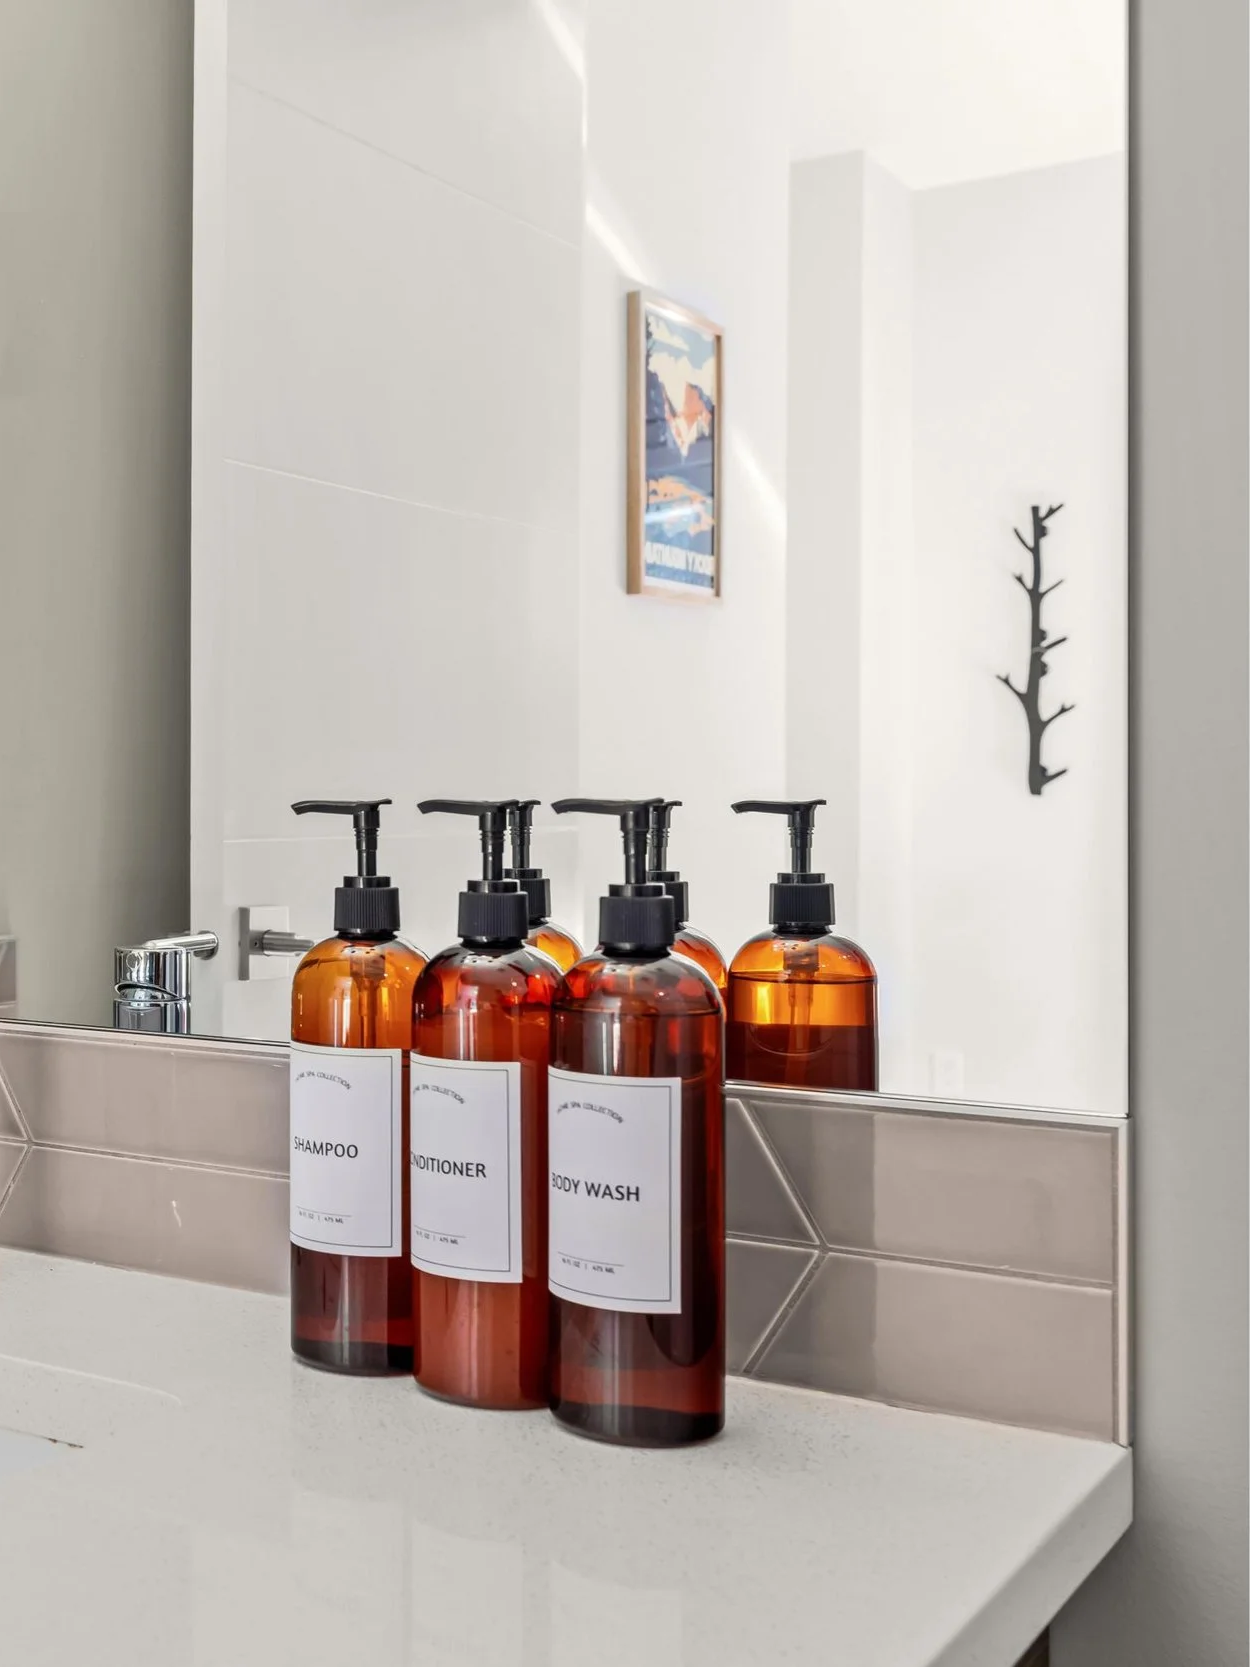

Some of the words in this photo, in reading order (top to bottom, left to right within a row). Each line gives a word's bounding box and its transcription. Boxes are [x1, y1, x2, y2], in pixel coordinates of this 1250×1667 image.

[316, 1071, 352, 1090] COLLECTION
[294, 1135, 359, 1159] SHAMPOO
[410, 1150, 487, 1178] ONDITIONER
[551, 1172, 580, 1195] BODY
[584, 1180, 640, 1202] WASH
